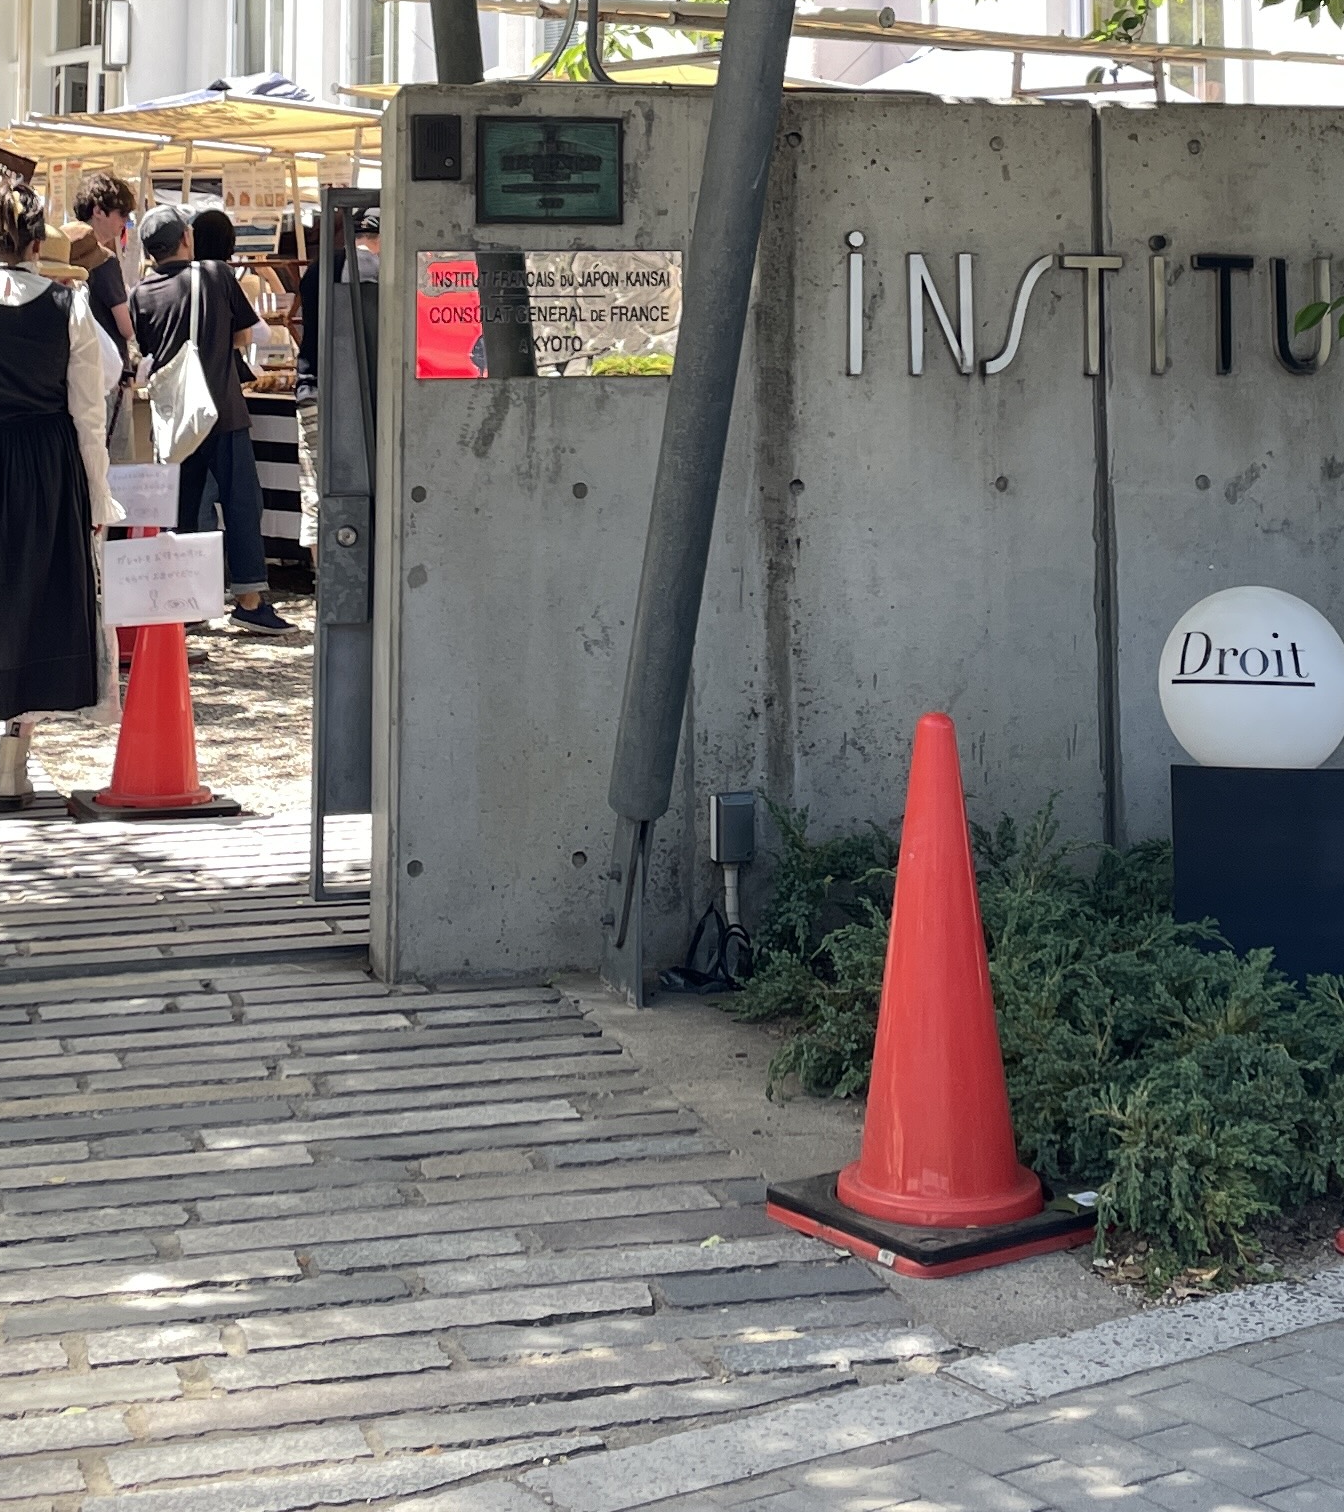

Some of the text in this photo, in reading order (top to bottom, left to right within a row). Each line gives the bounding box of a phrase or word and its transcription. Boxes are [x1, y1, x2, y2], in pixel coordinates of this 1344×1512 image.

[431, 271, 488, 287] INSTITUT
[560, 274, 574, 287] DU
[429, 305, 670, 324] CONSULAT GENERAL DE FRANCE
[533, 335, 583, 353] KYOTO
[1175, 631, 1310, 679] Droit
